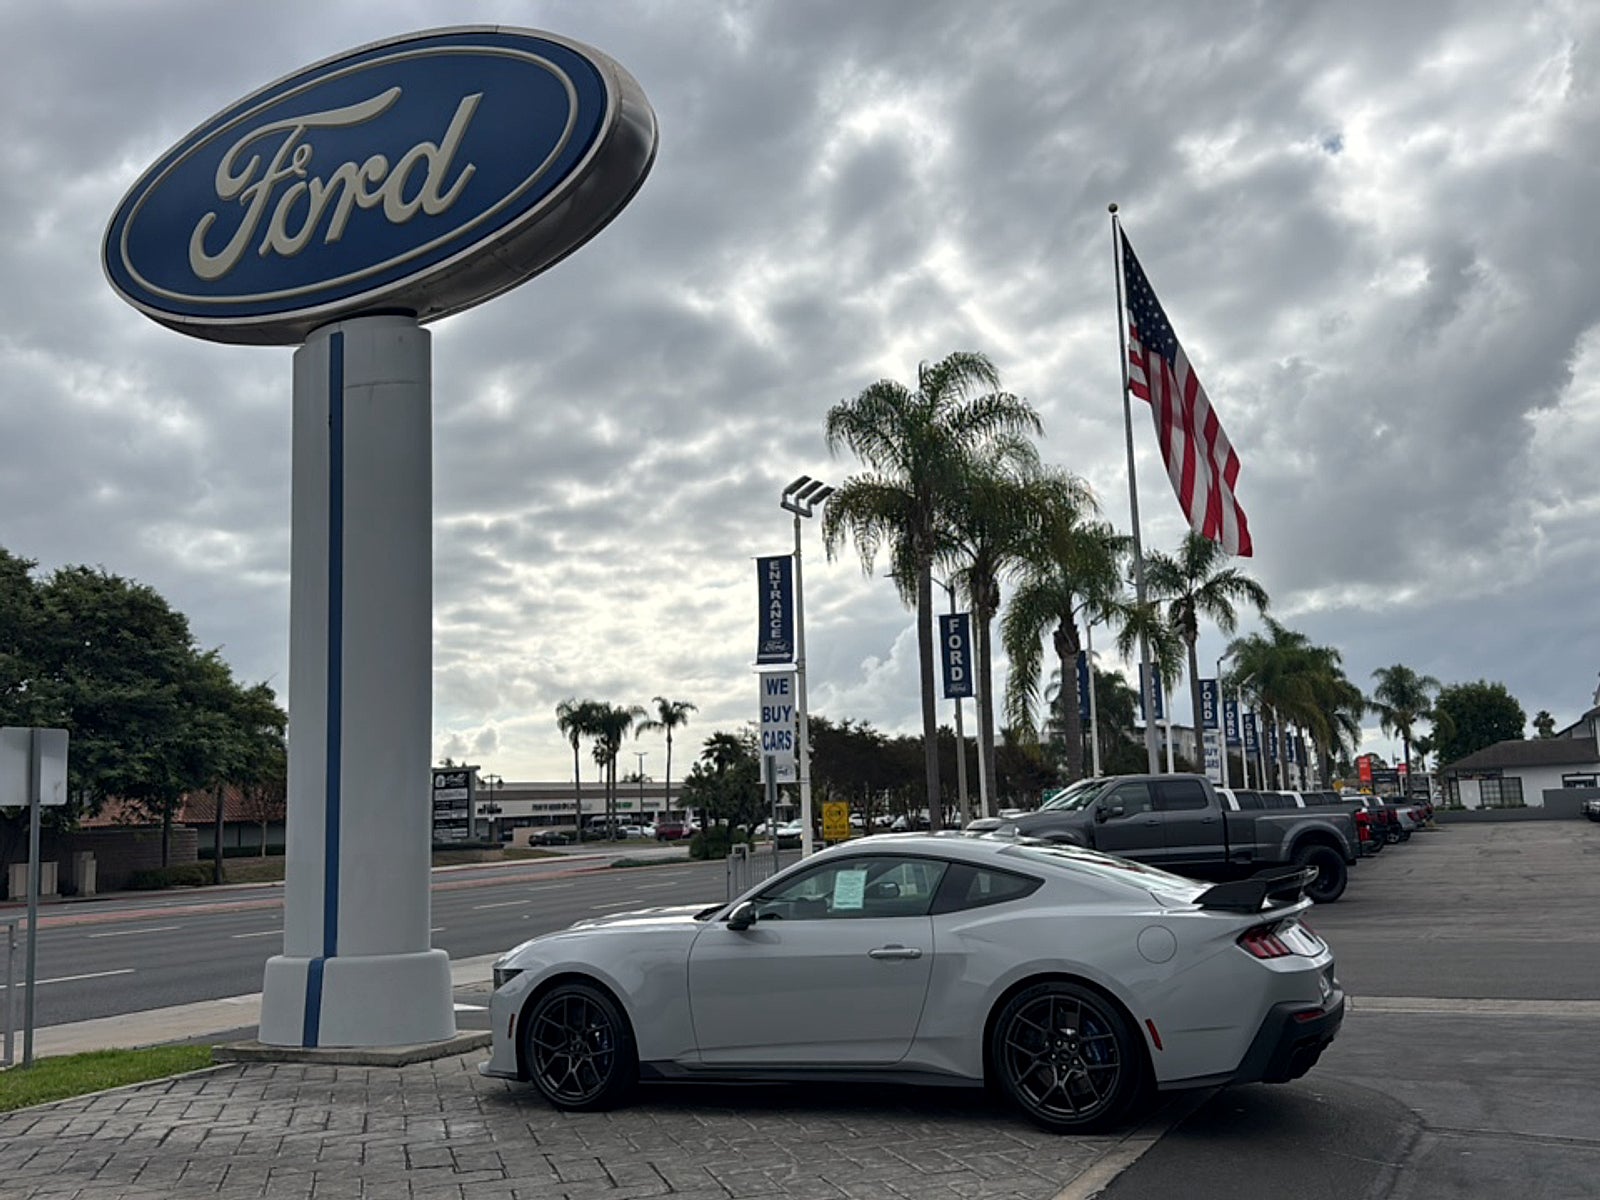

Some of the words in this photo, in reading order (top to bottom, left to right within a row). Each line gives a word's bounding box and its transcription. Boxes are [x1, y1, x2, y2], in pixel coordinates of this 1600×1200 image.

[189, 86, 484, 281] Ford
[769, 560, 782, 638] ENTRANCE
[948, 618, 963, 682] FORD
[766, 678, 789, 695] WE
[1203, 682, 1213, 720] FORD
[762, 705, 792, 723] BUY
[1226, 703, 1235, 736] FORD
[762, 730, 792, 751] CARS
